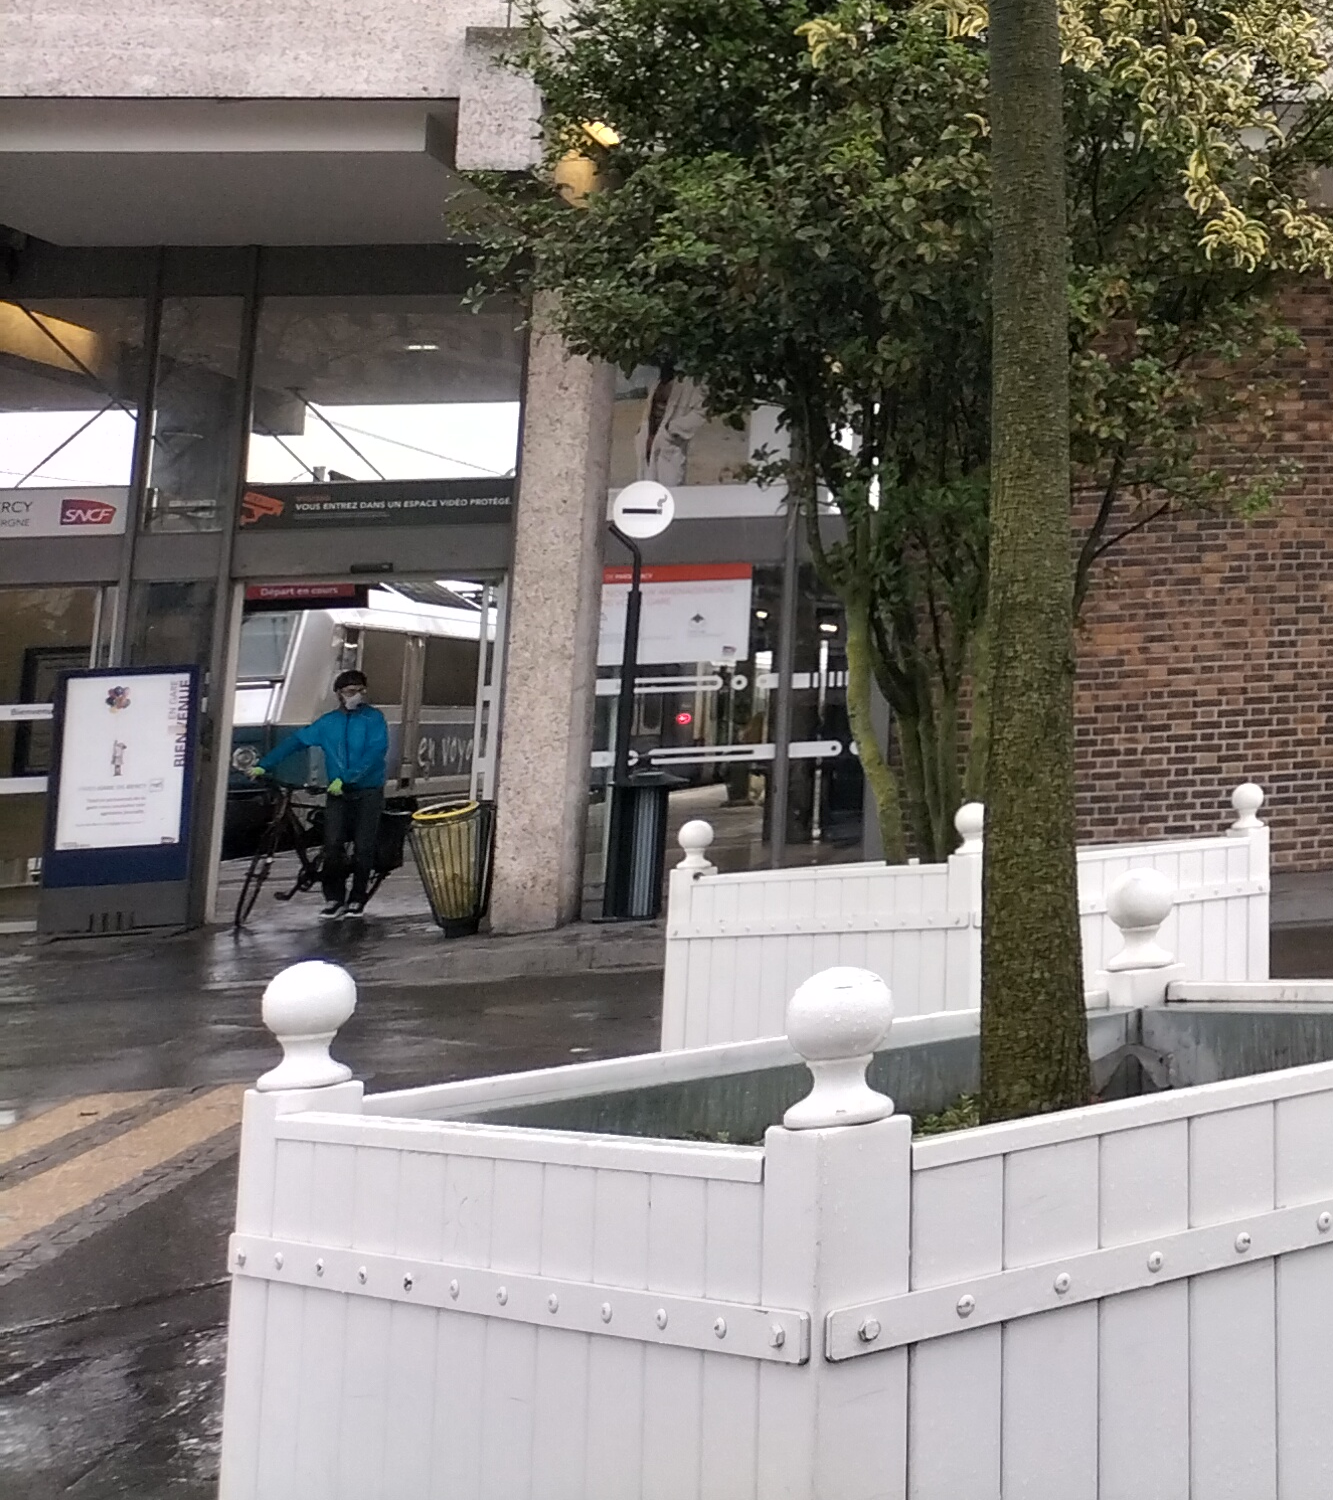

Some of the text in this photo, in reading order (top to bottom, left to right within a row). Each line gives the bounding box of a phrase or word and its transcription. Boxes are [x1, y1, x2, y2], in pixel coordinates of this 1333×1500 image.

[0, 501, 33, 513] RCY
[295, 502, 321, 511] VOUS
[323, 501, 358, 510] ENTREZ
[359, 501, 386, 510] DANS
[387, 500, 401, 509] UN
[403, 499, 438, 508] ESPACE
[439, 497, 468, 507] VIDÉO
[62, 508, 113, 522] SNCF
[0, 518, 30, 527] RGNE
[260, 586, 338, 598] Départ en cours
